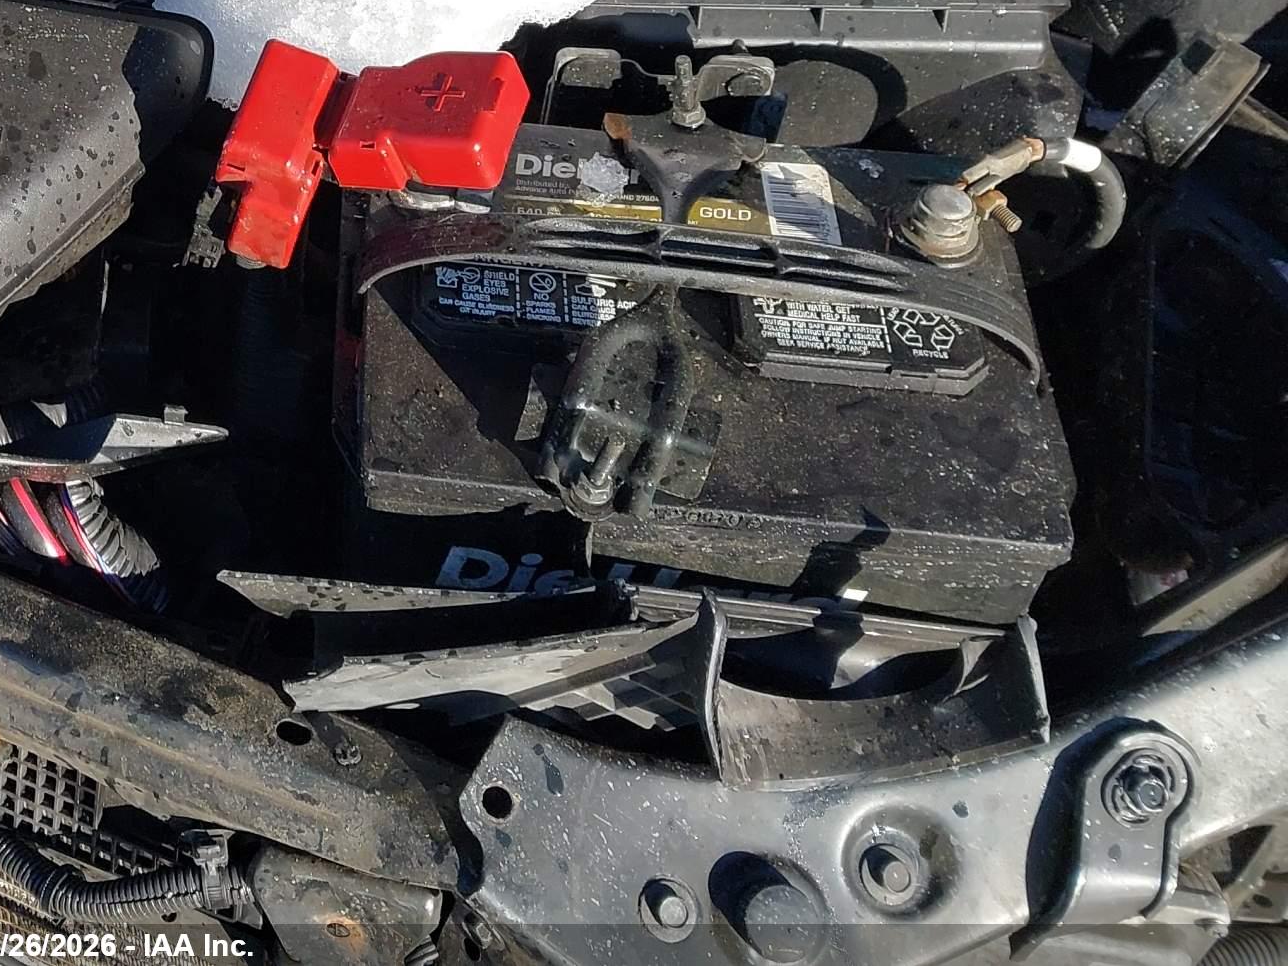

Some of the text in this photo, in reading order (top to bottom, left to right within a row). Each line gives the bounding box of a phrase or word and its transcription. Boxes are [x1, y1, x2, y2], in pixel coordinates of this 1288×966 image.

[699, 206, 752, 221] GOLD
[483, 270, 516, 281] SHIELD
[484, 279, 506, 287] EYES
[462, 284, 509, 296] EXPLOSIVE
[462, 292, 491, 302] GASES
[533, 292, 550, 301] NO
[571, 296, 615, 307] SULFURIC
[525, 300, 557, 309] SPARKS
[786, 301, 806, 311] WITH
[836, 306, 851, 315] GET
[526, 307, 556, 316] FLAMES
[787, 310, 861, 323] MEDICAL HELP FAST
[763, 324, 881, 341] FOLLOW INSTRUCTIONS IN VEHICLE
[793, 321, 806, 329] FOR
[808, 322, 825, 331] SAFE
[828, 324, 846, 333] JUMP
[848, 325, 882, 335] STARTING
[797, 341, 825, 350] SERVICE
[832, 336, 846, 344] NOT
[849, 338, 885, 349] AVAILABLE
[912, 349, 949, 360] RECYCLE
